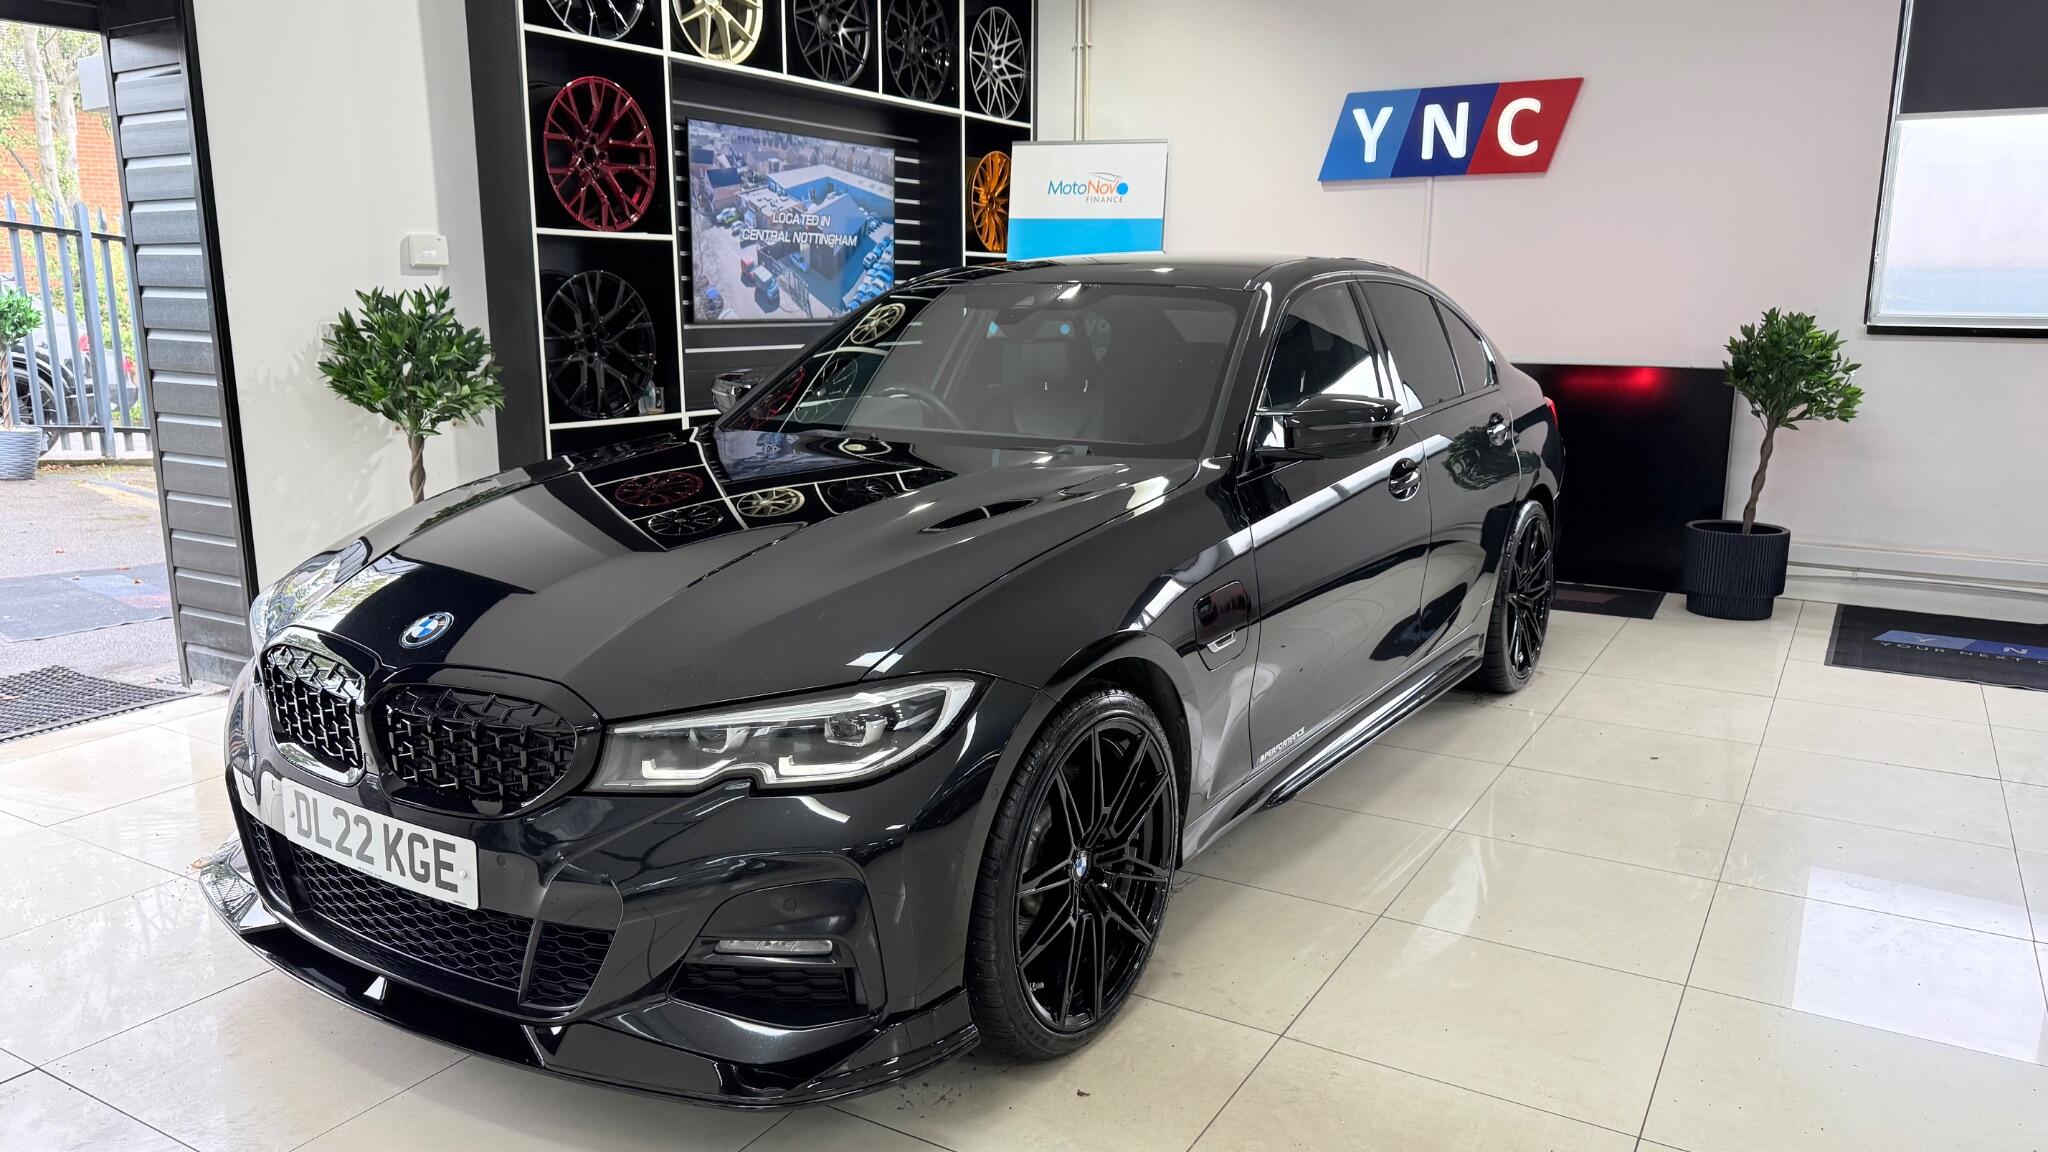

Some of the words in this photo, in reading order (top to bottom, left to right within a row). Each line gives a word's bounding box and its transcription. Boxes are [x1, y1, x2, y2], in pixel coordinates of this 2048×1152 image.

[1352, 97, 1542, 163] YNC
[1085, 195, 1124, 204] FINANCE
[772, 211, 819, 227] LOCATED
[821, 215, 831, 227] IN
[742, 229, 790, 243] CENTRAL
[792, 231, 858, 247] NOTTINGHAM
[1880, 641, 1945, 653] YOUR
[1960, 651, 2022, 662] NEXT
[293, 789, 375, 866] DL22
[383, 822, 459, 893] KGE
